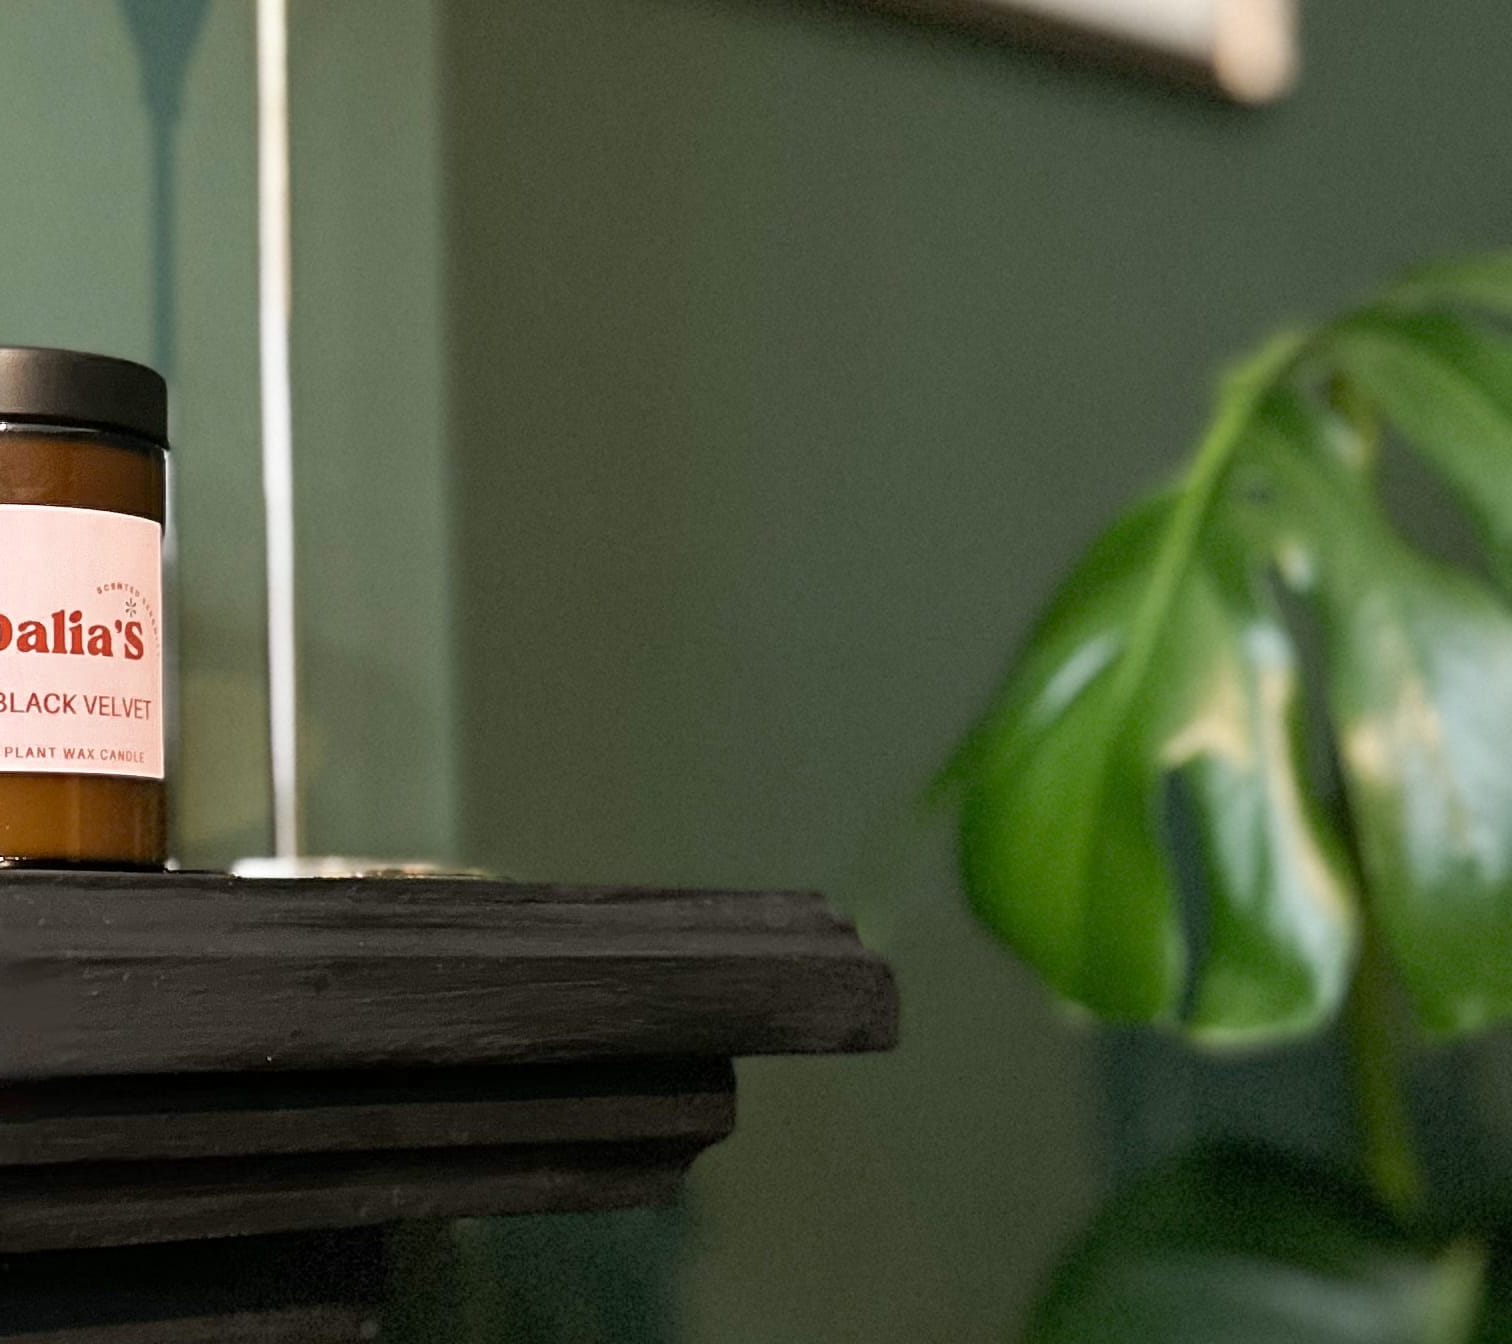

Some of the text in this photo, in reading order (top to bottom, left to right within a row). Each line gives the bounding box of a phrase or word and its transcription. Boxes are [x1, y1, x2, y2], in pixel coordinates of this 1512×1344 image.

[82, 695, 152, 721] VELVET
[4, 746, 145, 763] PLANT WAX CANDLE
